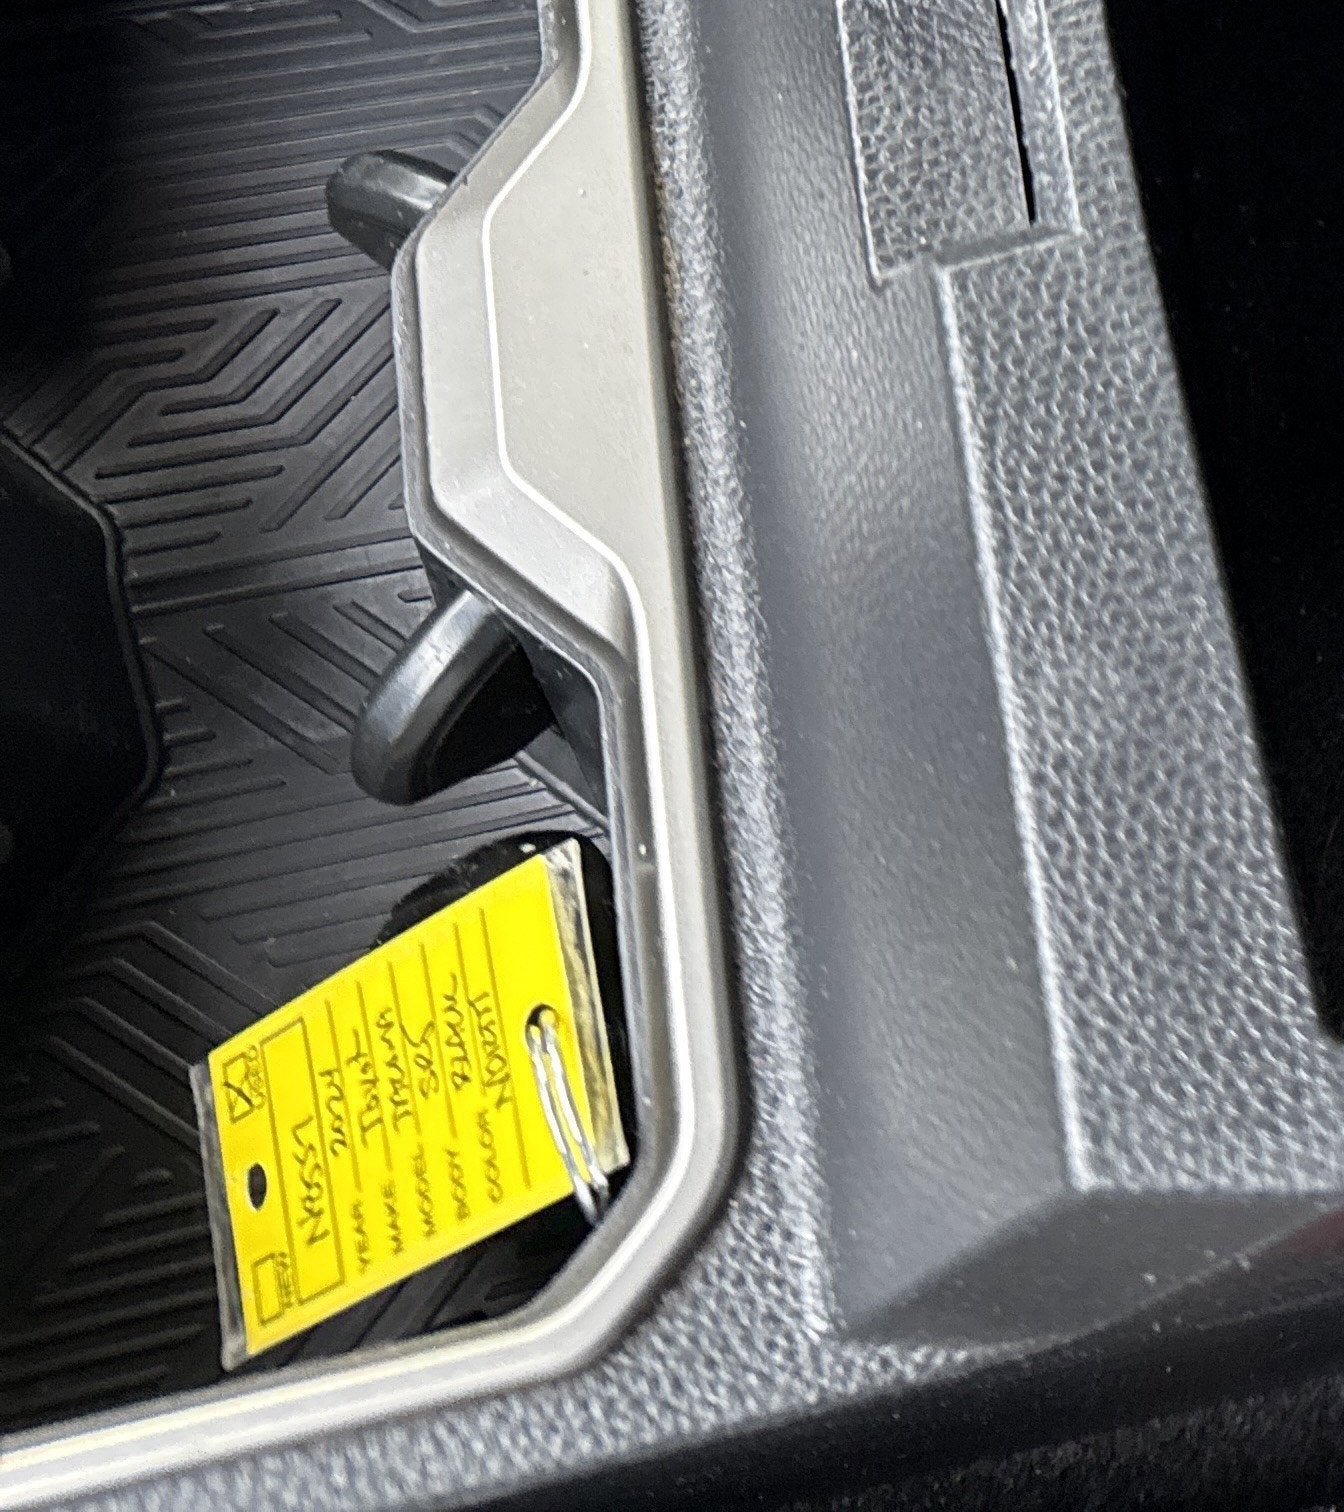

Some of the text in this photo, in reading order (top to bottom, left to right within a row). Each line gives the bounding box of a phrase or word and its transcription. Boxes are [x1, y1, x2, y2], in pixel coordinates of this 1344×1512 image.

[319, 1064, 370, 1272] YEAR 2024
[412, 1142, 435, 1238] MODEL
[446, 1148, 469, 1222] BODY
[477, 1108, 502, 1205] COLOR
[382, 1179, 403, 1255] MAKE
